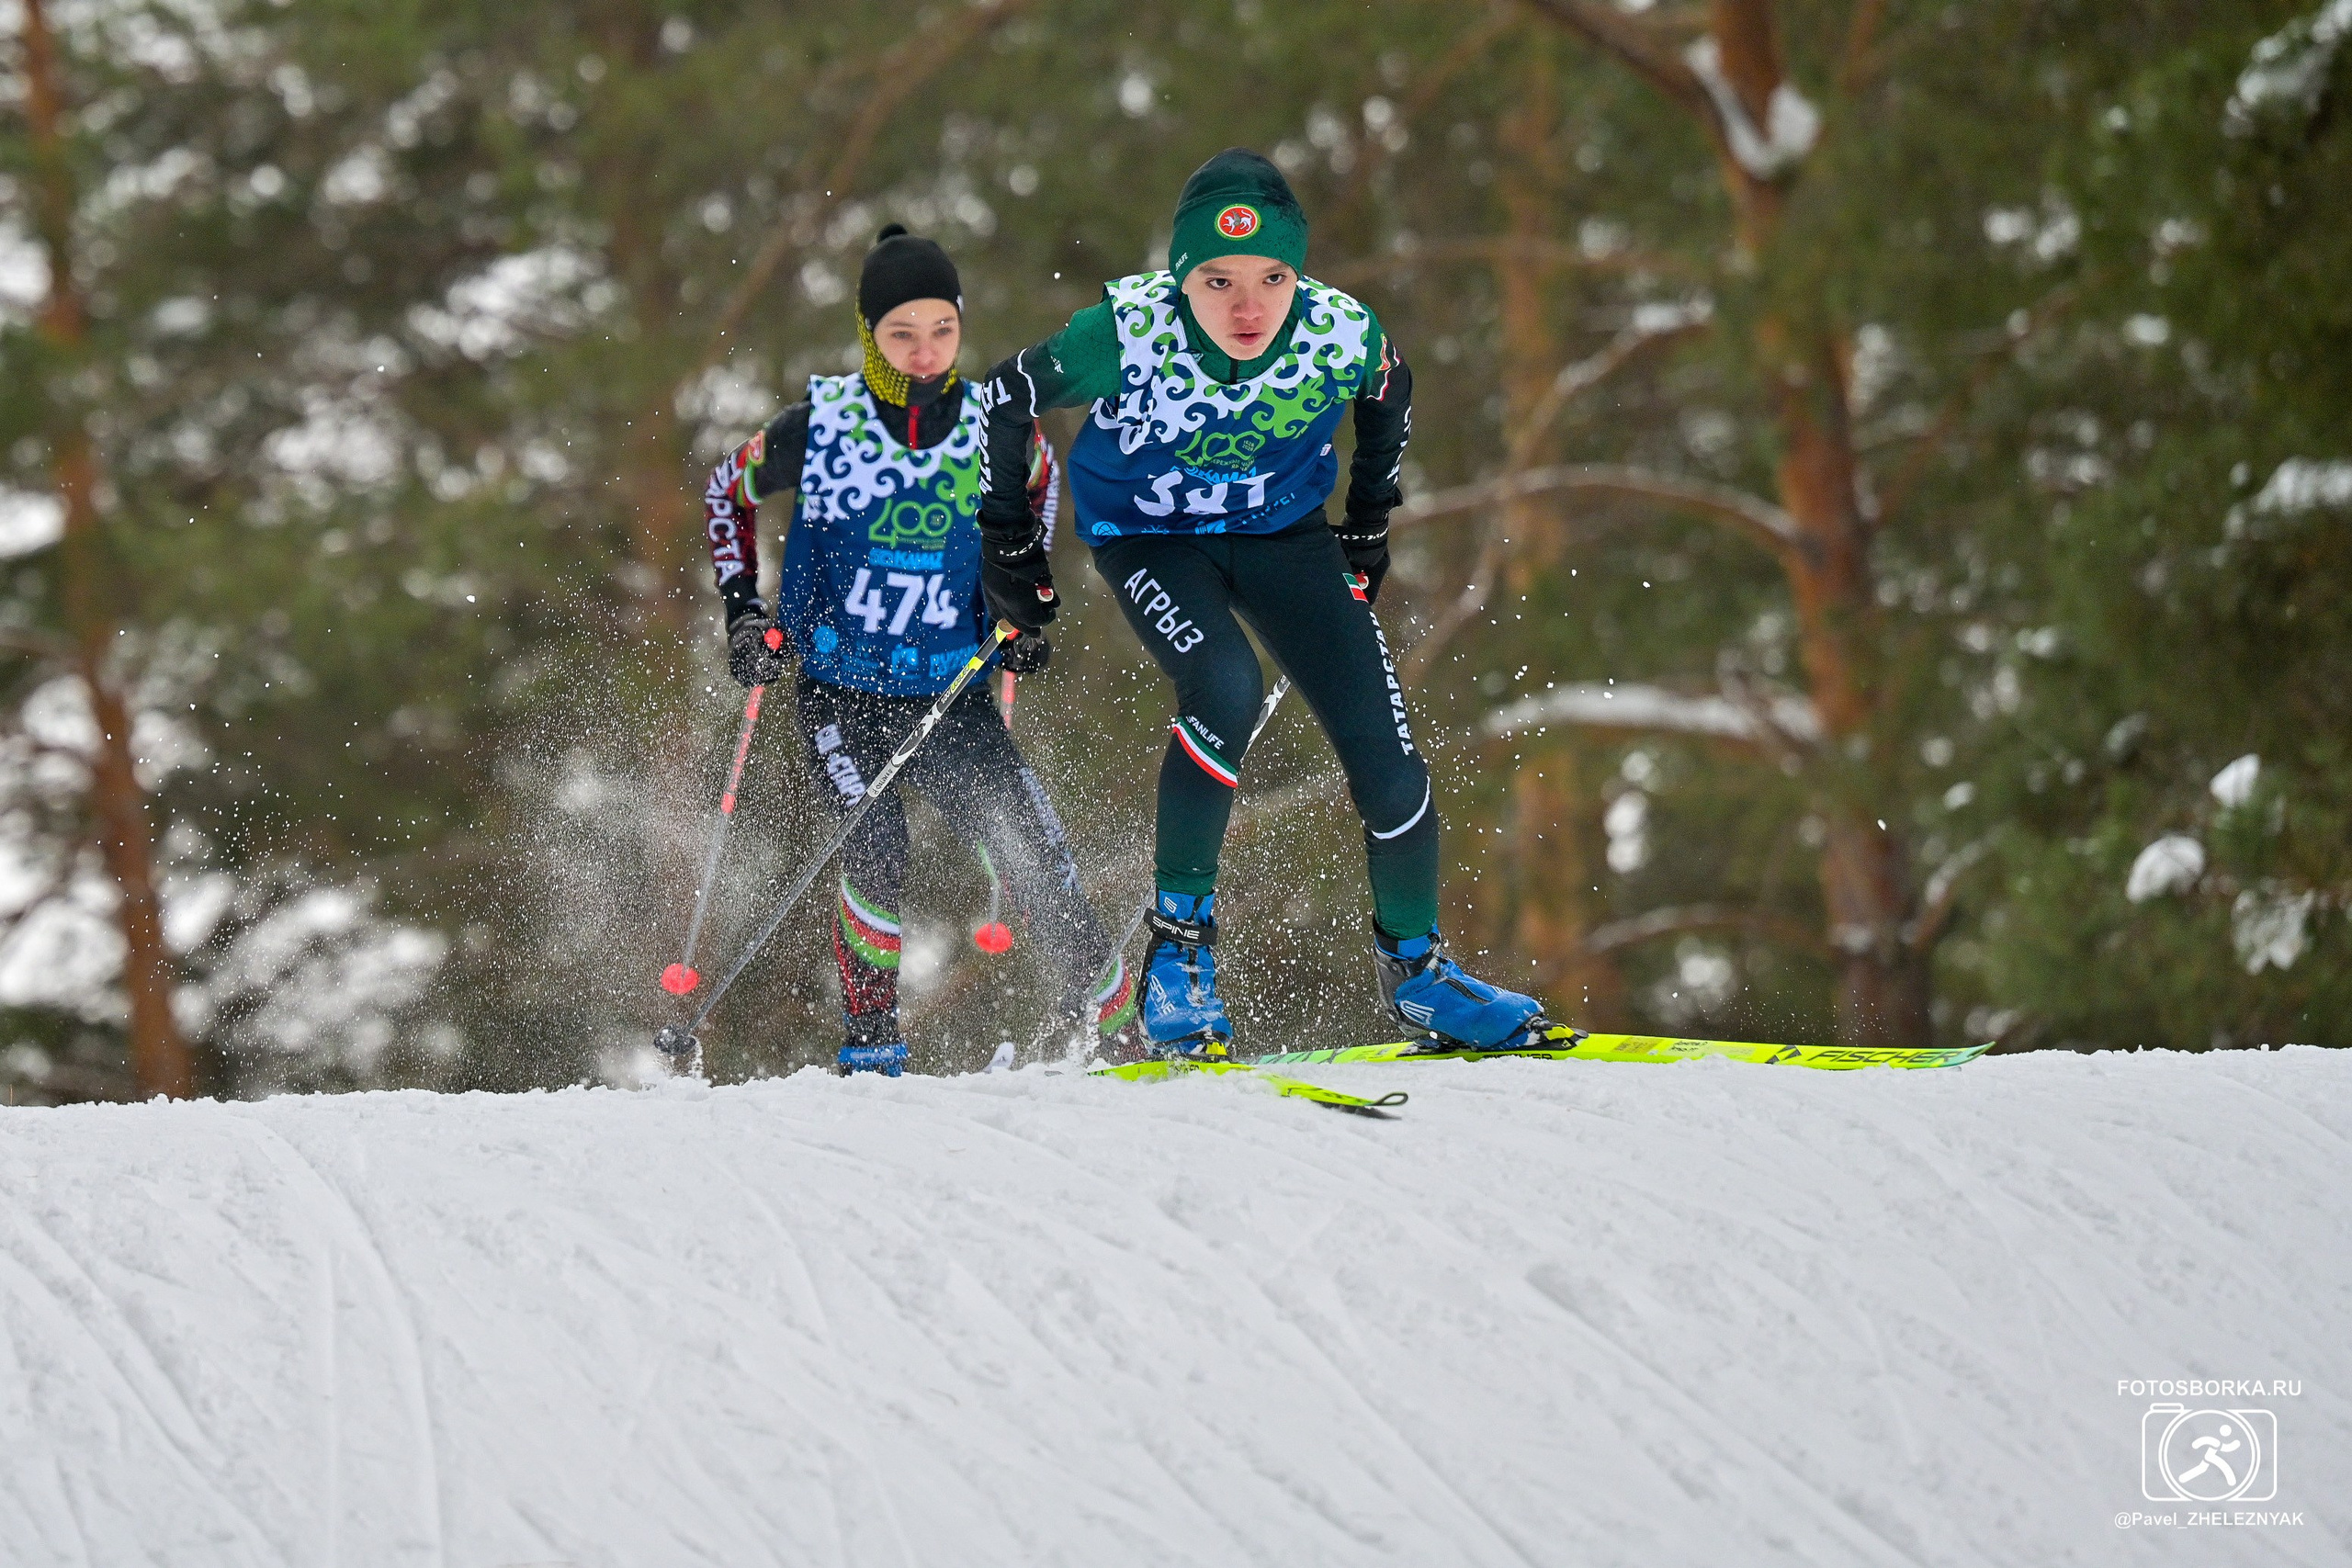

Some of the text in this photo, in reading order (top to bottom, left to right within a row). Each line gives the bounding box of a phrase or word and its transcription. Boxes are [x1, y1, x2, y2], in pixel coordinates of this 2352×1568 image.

[1175, 430, 1265, 468] 400
[868, 497, 953, 549] 400
[844, 567, 960, 637] 474
[1124, 568, 1204, 653] АГРЫЗ
[1189, 716, 1225, 750] FANLIFE
[1152, 916, 1200, 940] SPINE
[1149, 974, 1176, 1016] SPINE
[1806, 1050, 1962, 1064] FISCHER
